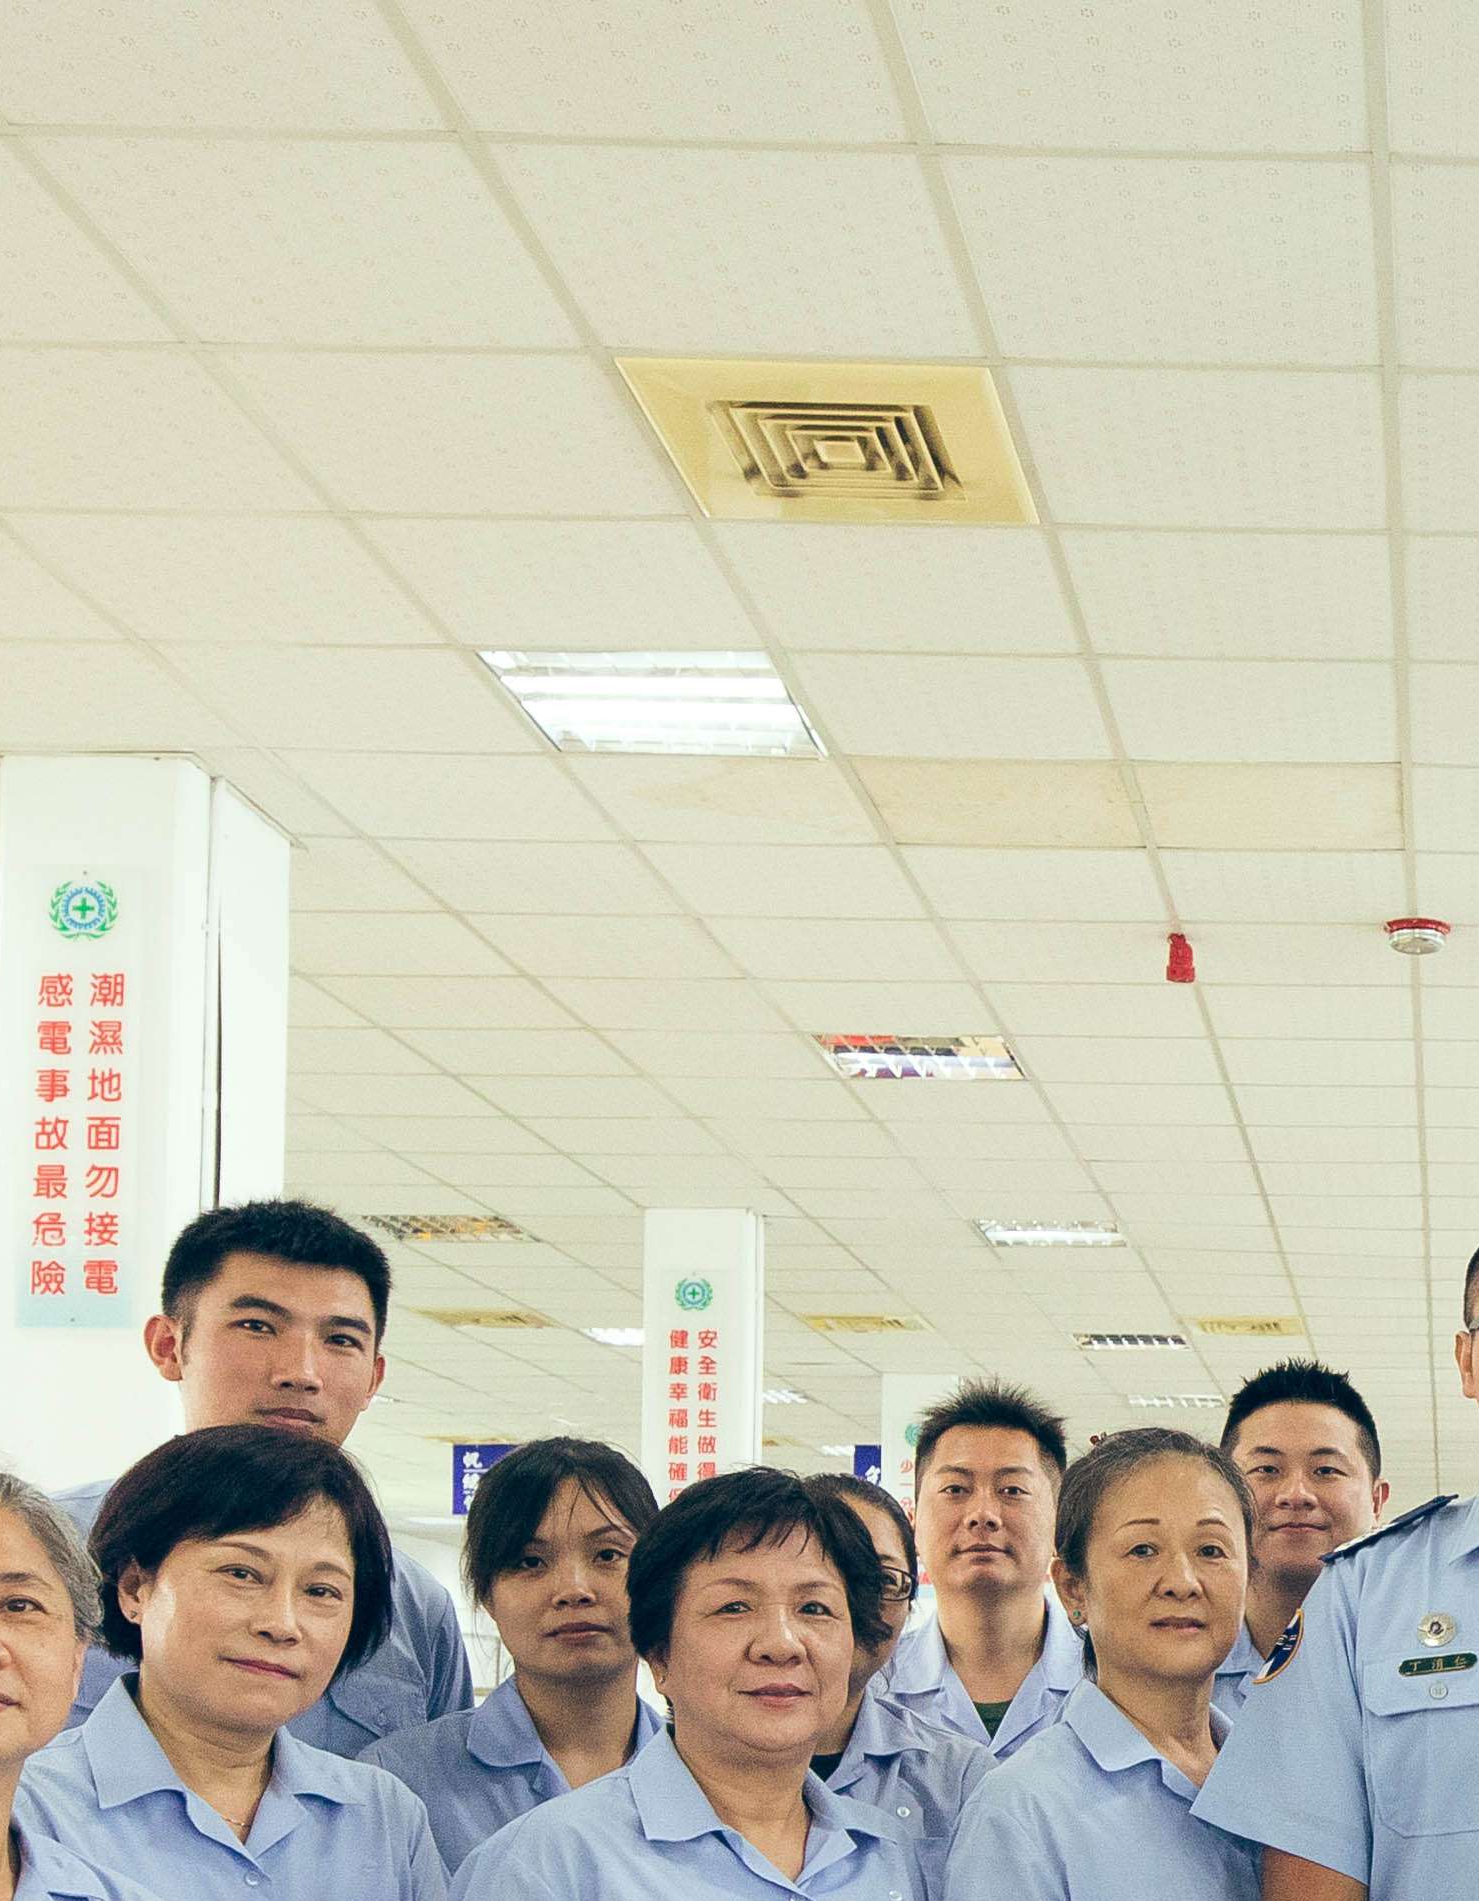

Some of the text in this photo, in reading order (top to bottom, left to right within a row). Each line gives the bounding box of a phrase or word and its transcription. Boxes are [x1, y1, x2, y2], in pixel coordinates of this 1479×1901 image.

[30, 972, 74, 1296] 感電事故最危險
[83, 972, 125, 1296] 潮濕地面勿接電
[696, 1328, 718, 1480] 安全衛生做得
